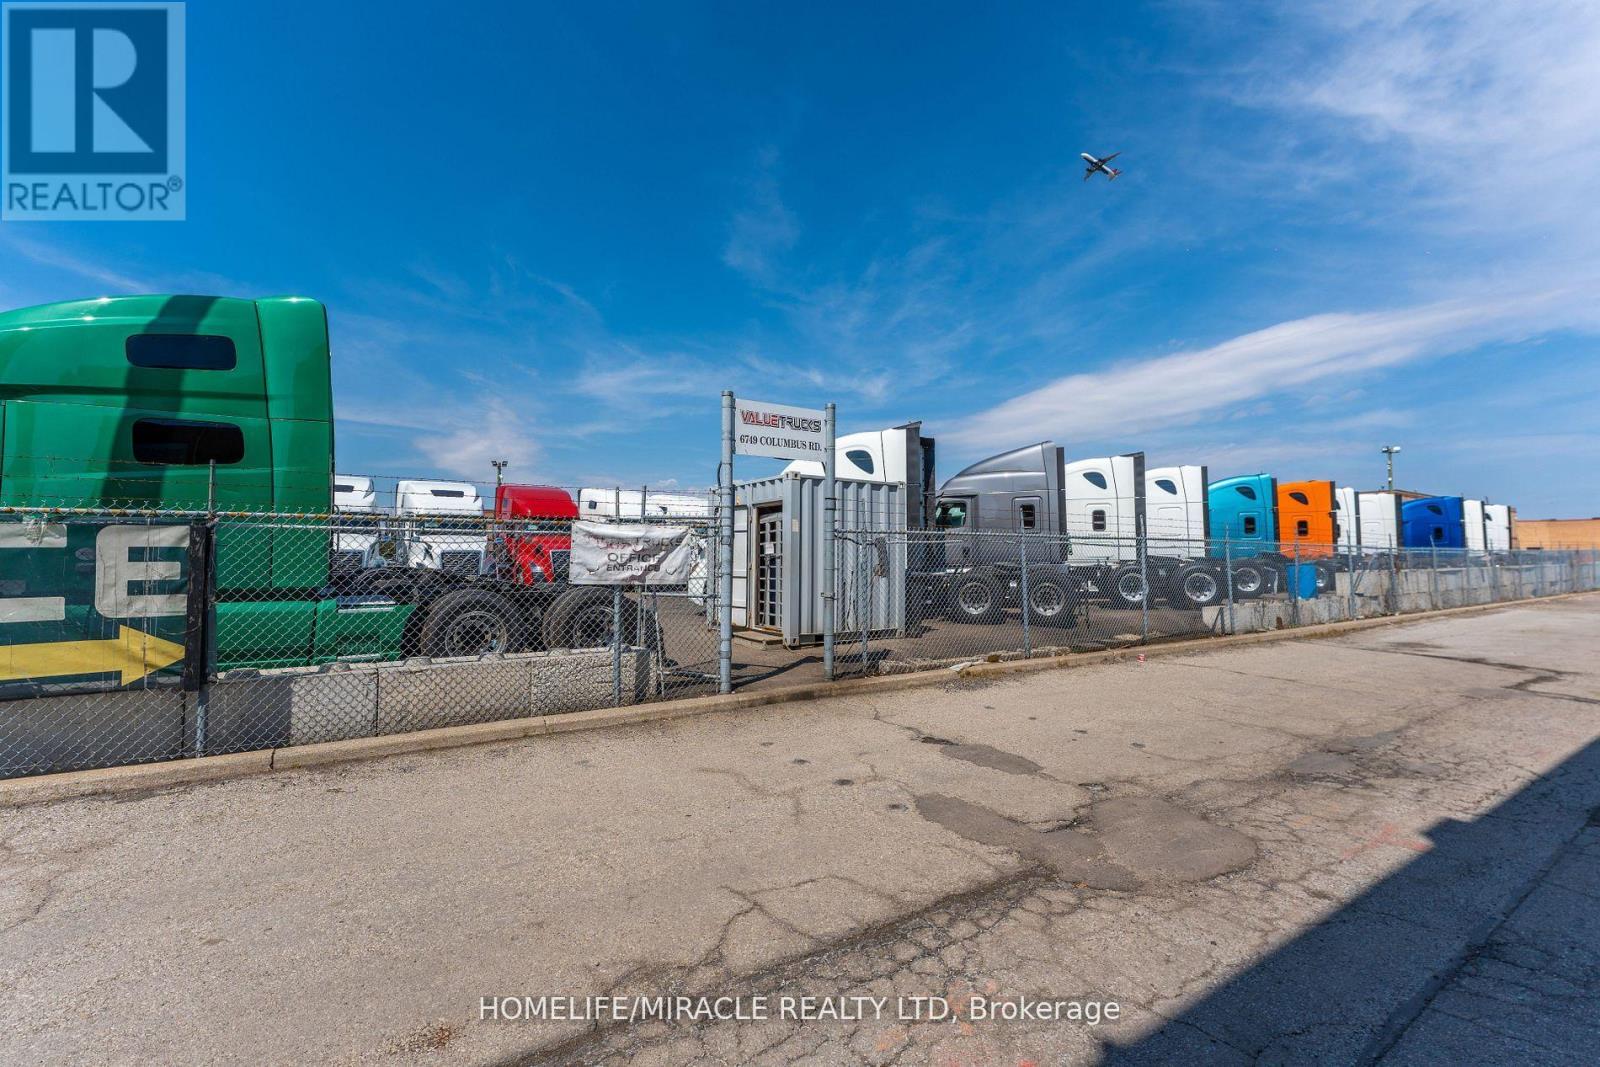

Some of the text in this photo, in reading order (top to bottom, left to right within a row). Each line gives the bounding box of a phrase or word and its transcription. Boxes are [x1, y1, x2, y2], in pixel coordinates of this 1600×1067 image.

[740, 434, 822, 451] 6749 COLUMBUS RD.
